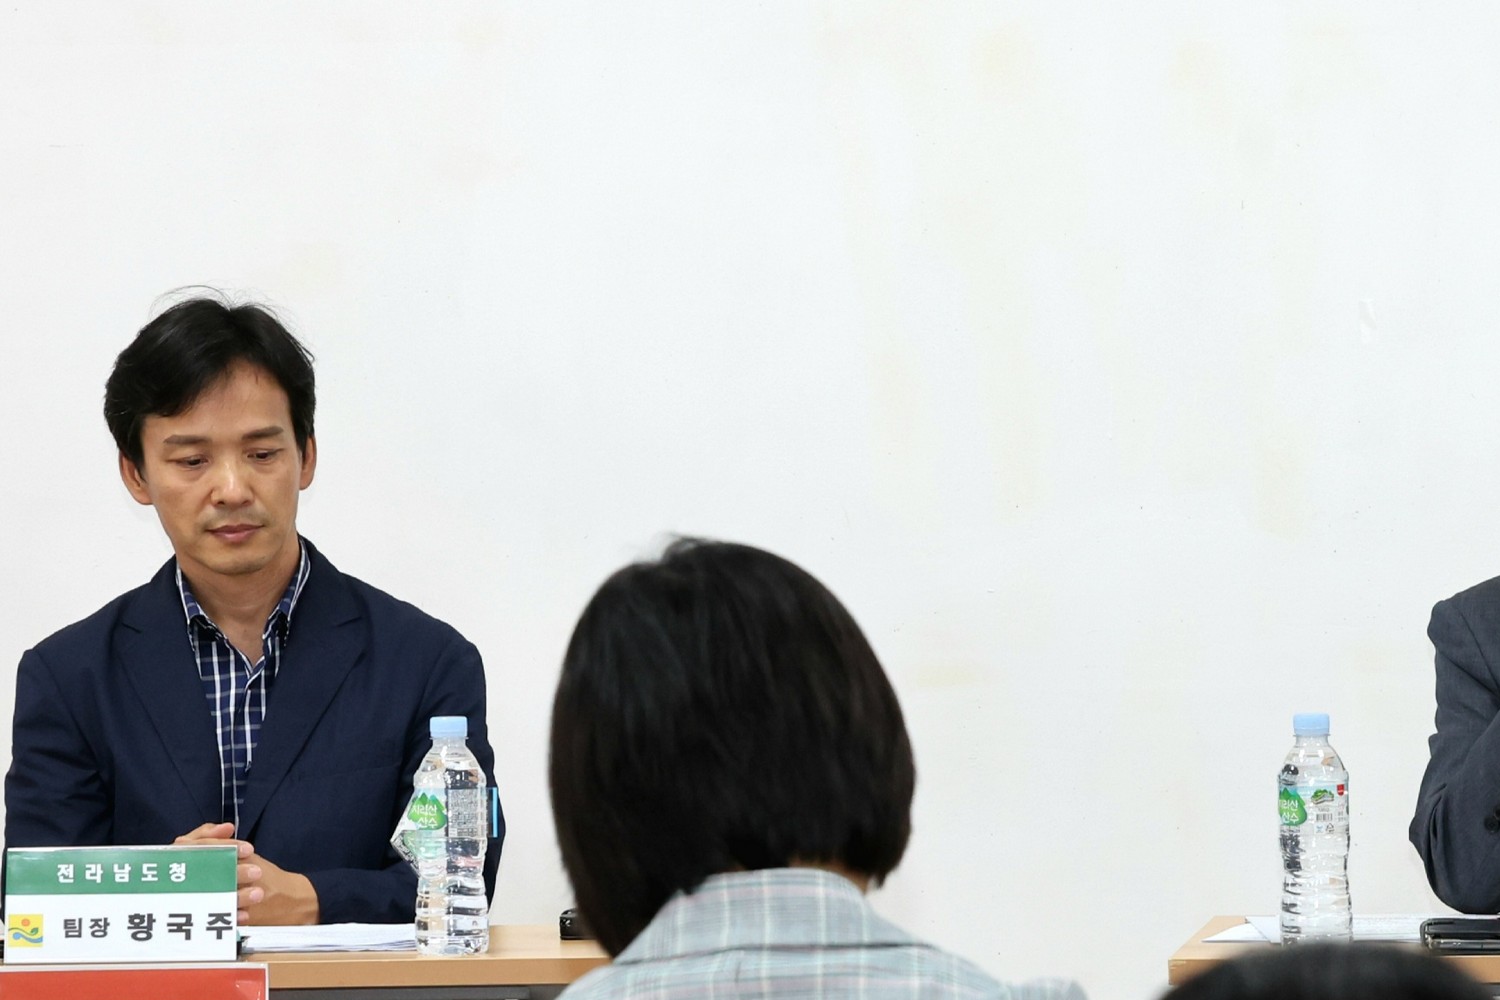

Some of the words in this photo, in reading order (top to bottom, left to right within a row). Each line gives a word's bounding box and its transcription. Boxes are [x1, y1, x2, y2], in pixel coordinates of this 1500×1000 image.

[418, 816, 439, 828] 산수
[57, 863, 187, 883] 전라남도청
[63, 917, 110, 939] 팀장
[127, 912, 233, 942] 황국주
